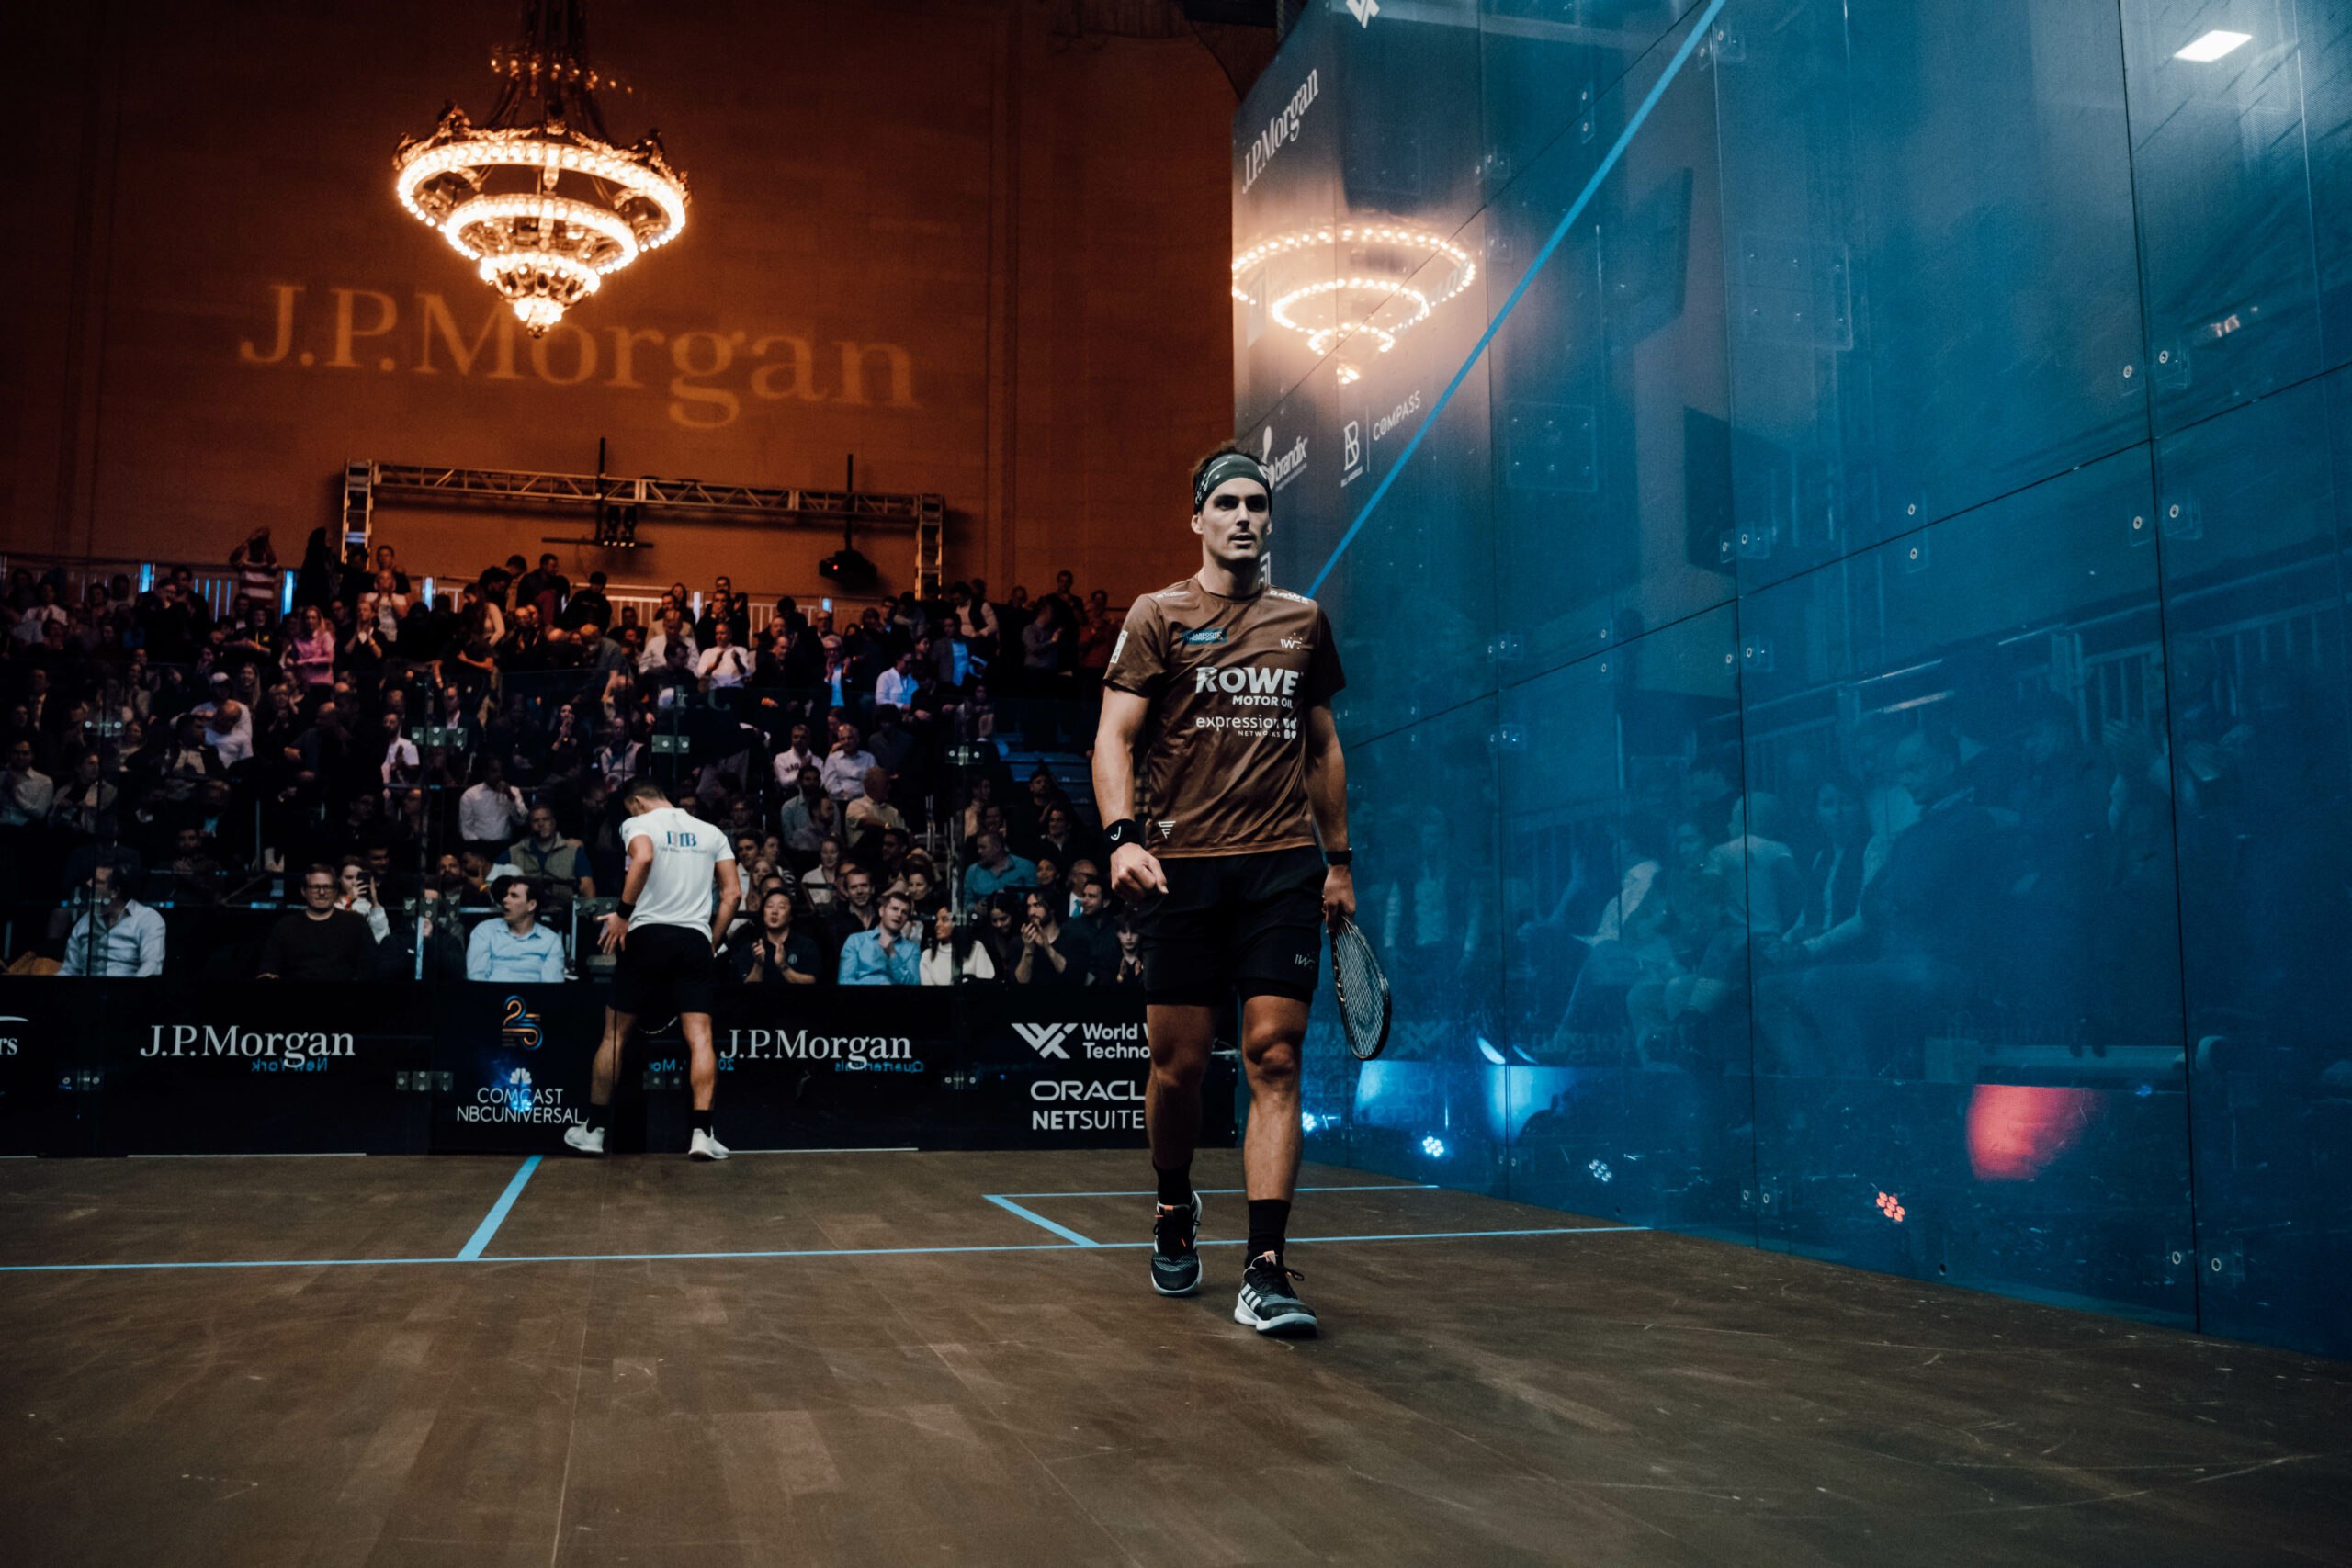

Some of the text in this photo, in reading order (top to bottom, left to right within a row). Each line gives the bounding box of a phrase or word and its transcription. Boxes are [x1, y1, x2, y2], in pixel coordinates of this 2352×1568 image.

[239, 284, 918, 429] J.P.Morgan
[1373, 389, 1421, 442] COMPASS
[1275, 435, 1309, 483] brandix
[1195, 666, 1299, 696] ROWE
[1232, 695, 1294, 710] MOTOR OIL
[1238, 729, 1281, 738] NETWOKS
[1082, 1023, 1138, 1040] World
[140, 1024, 356, 1067] J.P.Morgan
[719, 1029, 912, 1070] J.P.Morgan
[1082, 1043, 1151, 1059] Techno
[477, 1087, 564, 1104] COMCAST
[1030, 1080, 1146, 1100] ORACL
[457, 1106, 583, 1124] NBCUNIVERSAL
[1032, 1110, 1145, 1130] NETSUITE
